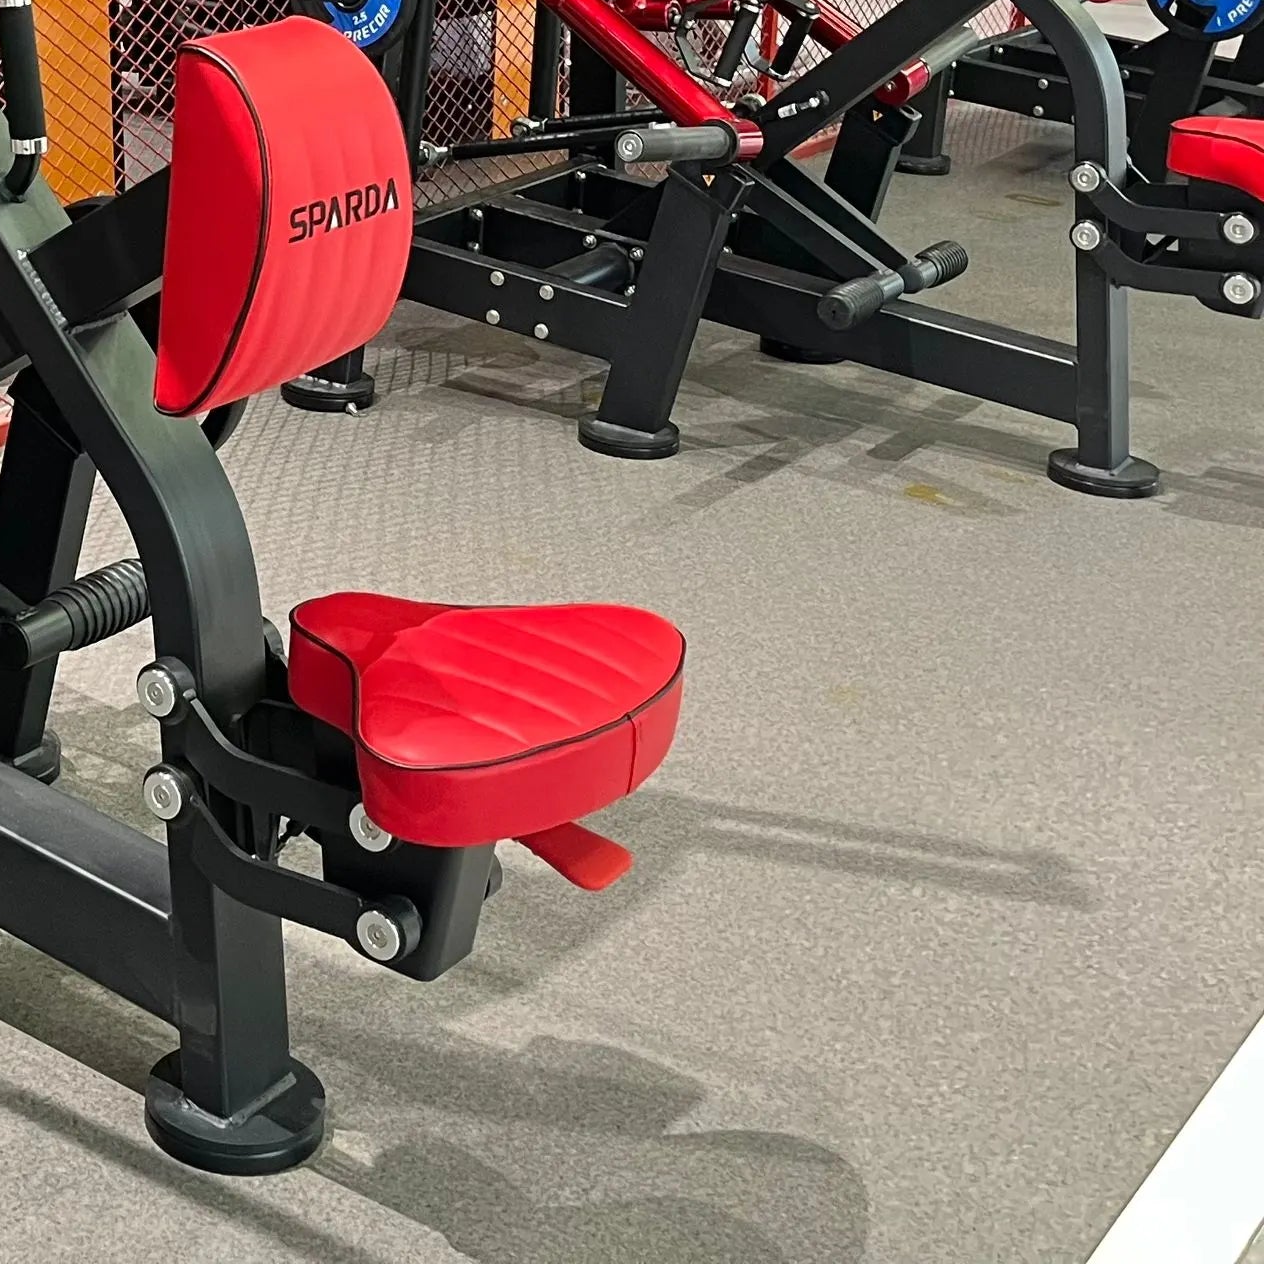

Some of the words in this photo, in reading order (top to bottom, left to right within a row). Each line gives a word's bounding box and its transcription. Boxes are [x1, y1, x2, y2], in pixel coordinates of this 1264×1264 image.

[343, 4, 391, 42] PRECOR
[352, 11, 368, 25] 2.5
[288, 177, 399, 244] SPARDA
